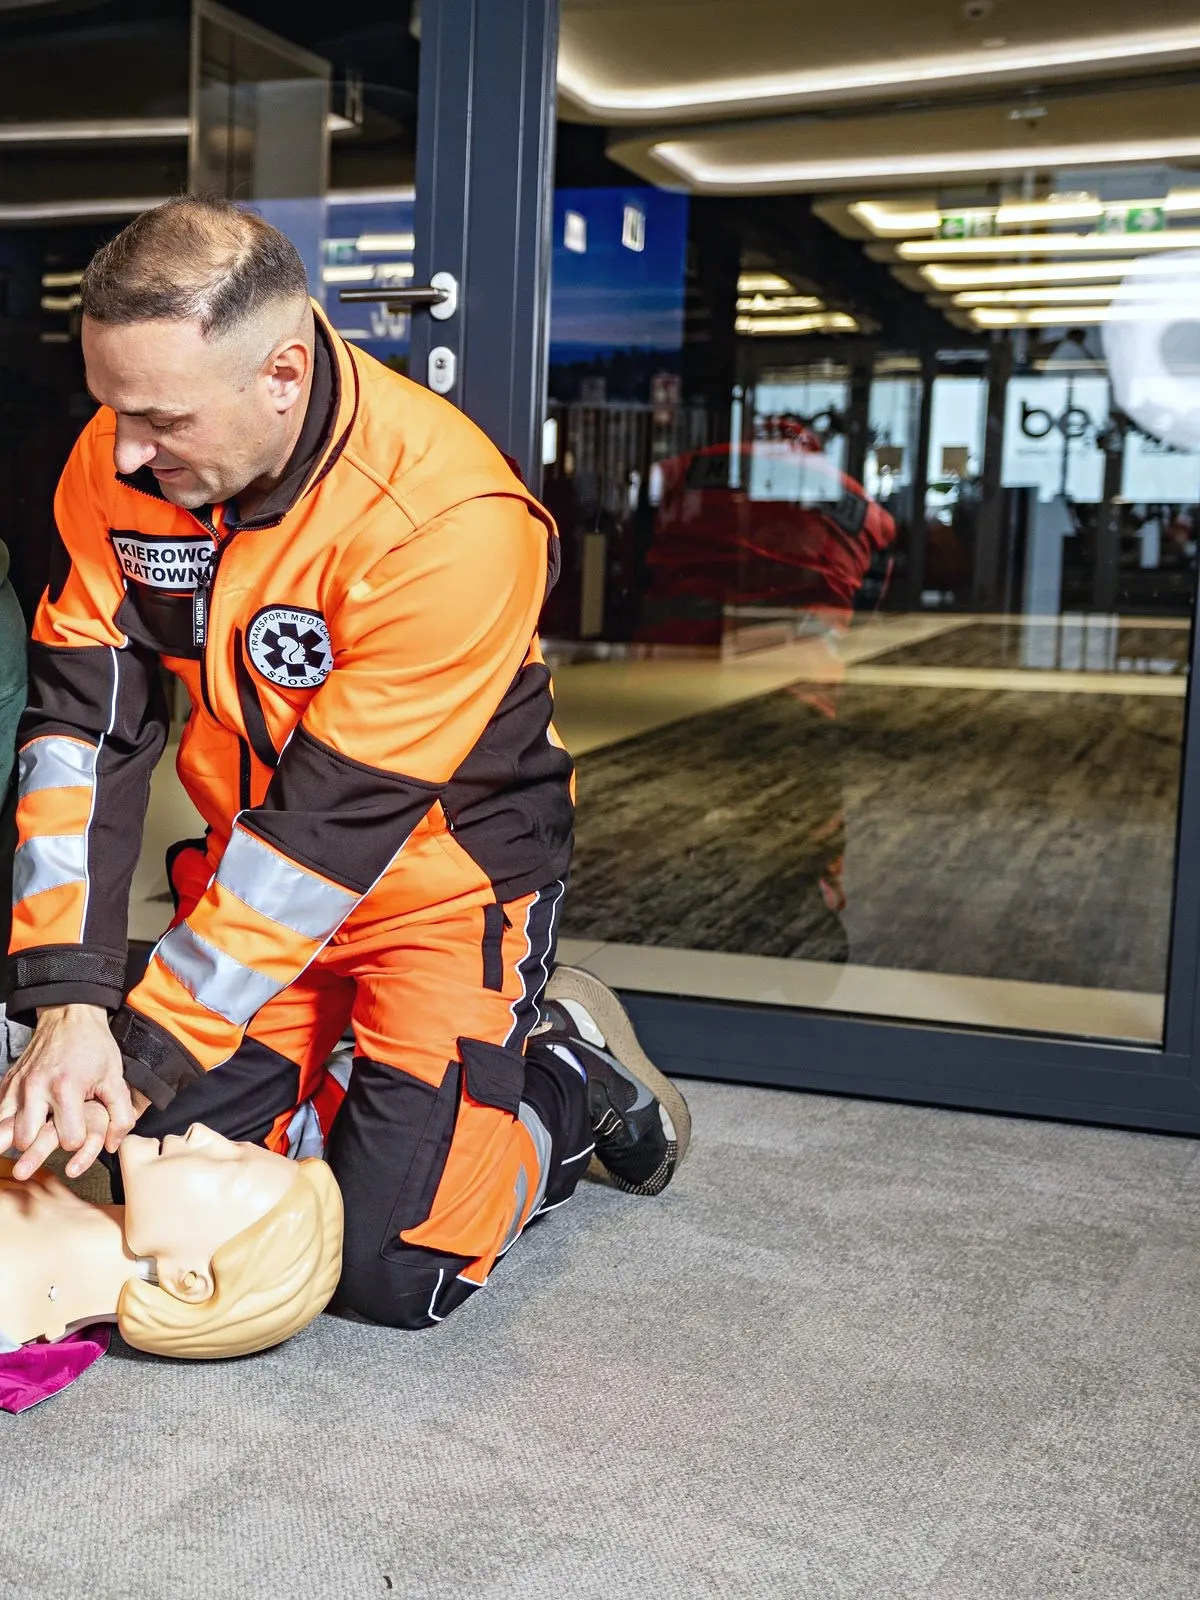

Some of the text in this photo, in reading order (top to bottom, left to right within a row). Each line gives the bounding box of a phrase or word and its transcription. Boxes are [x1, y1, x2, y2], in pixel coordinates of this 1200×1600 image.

[118, 543, 211, 563] KIEROWC
[196, 598, 204, 643] THERMO PILE
[252, 612, 287, 651] TRANSPORT
[267, 669, 329, 685] STOCER
